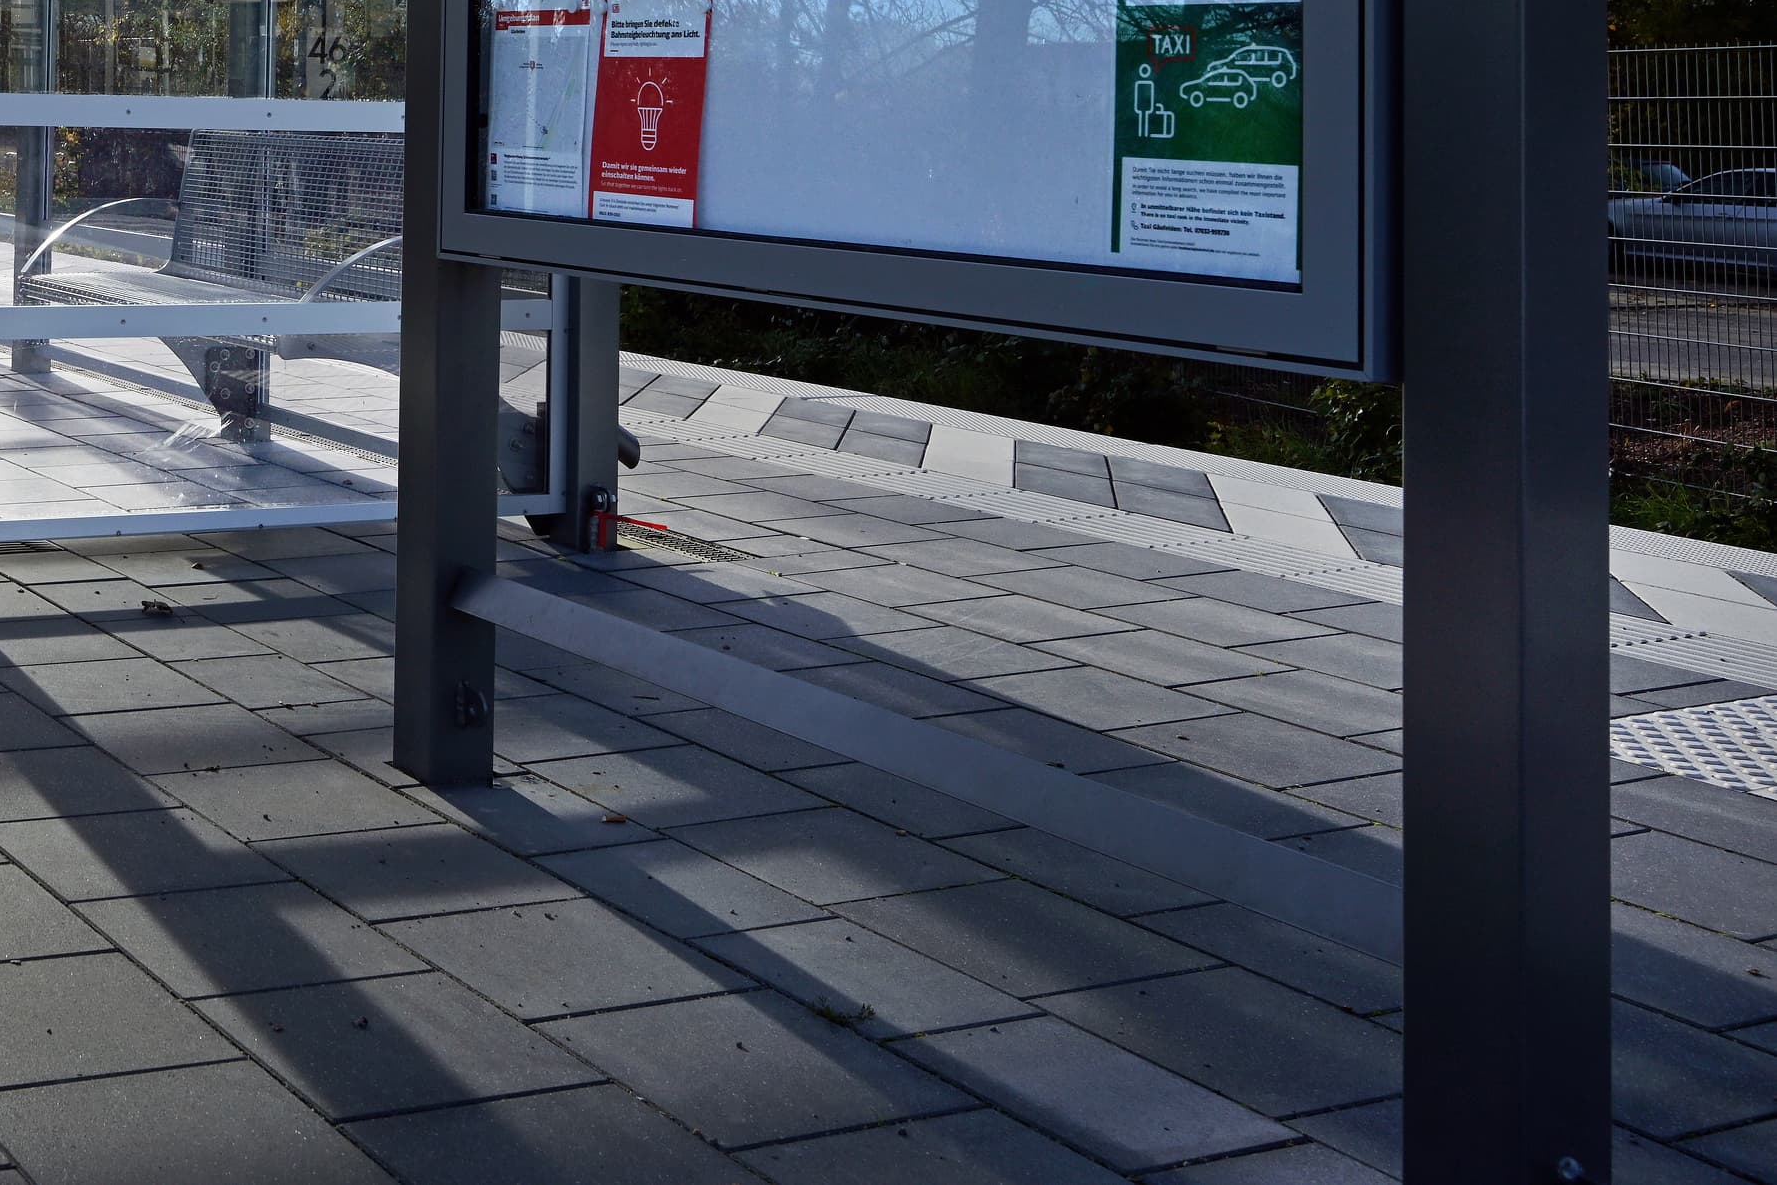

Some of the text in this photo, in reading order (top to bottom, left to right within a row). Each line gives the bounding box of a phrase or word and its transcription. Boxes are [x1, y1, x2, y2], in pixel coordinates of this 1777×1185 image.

[611, 19, 680, 30] Bitte bringen Sie defekte
[611, 29, 701, 40] Bahnsteigbeleuchtung ans Licht.
[308, 32, 347, 64] 46
[1151, 33, 1192, 56] TAXI
[603, 162, 621, 170] Damit
[621, 163, 630, 171] wir
[638, 165, 669, 174] gemeinsam
[669, 166, 687, 175] wieder
[602, 171, 634, 180] einschalten
